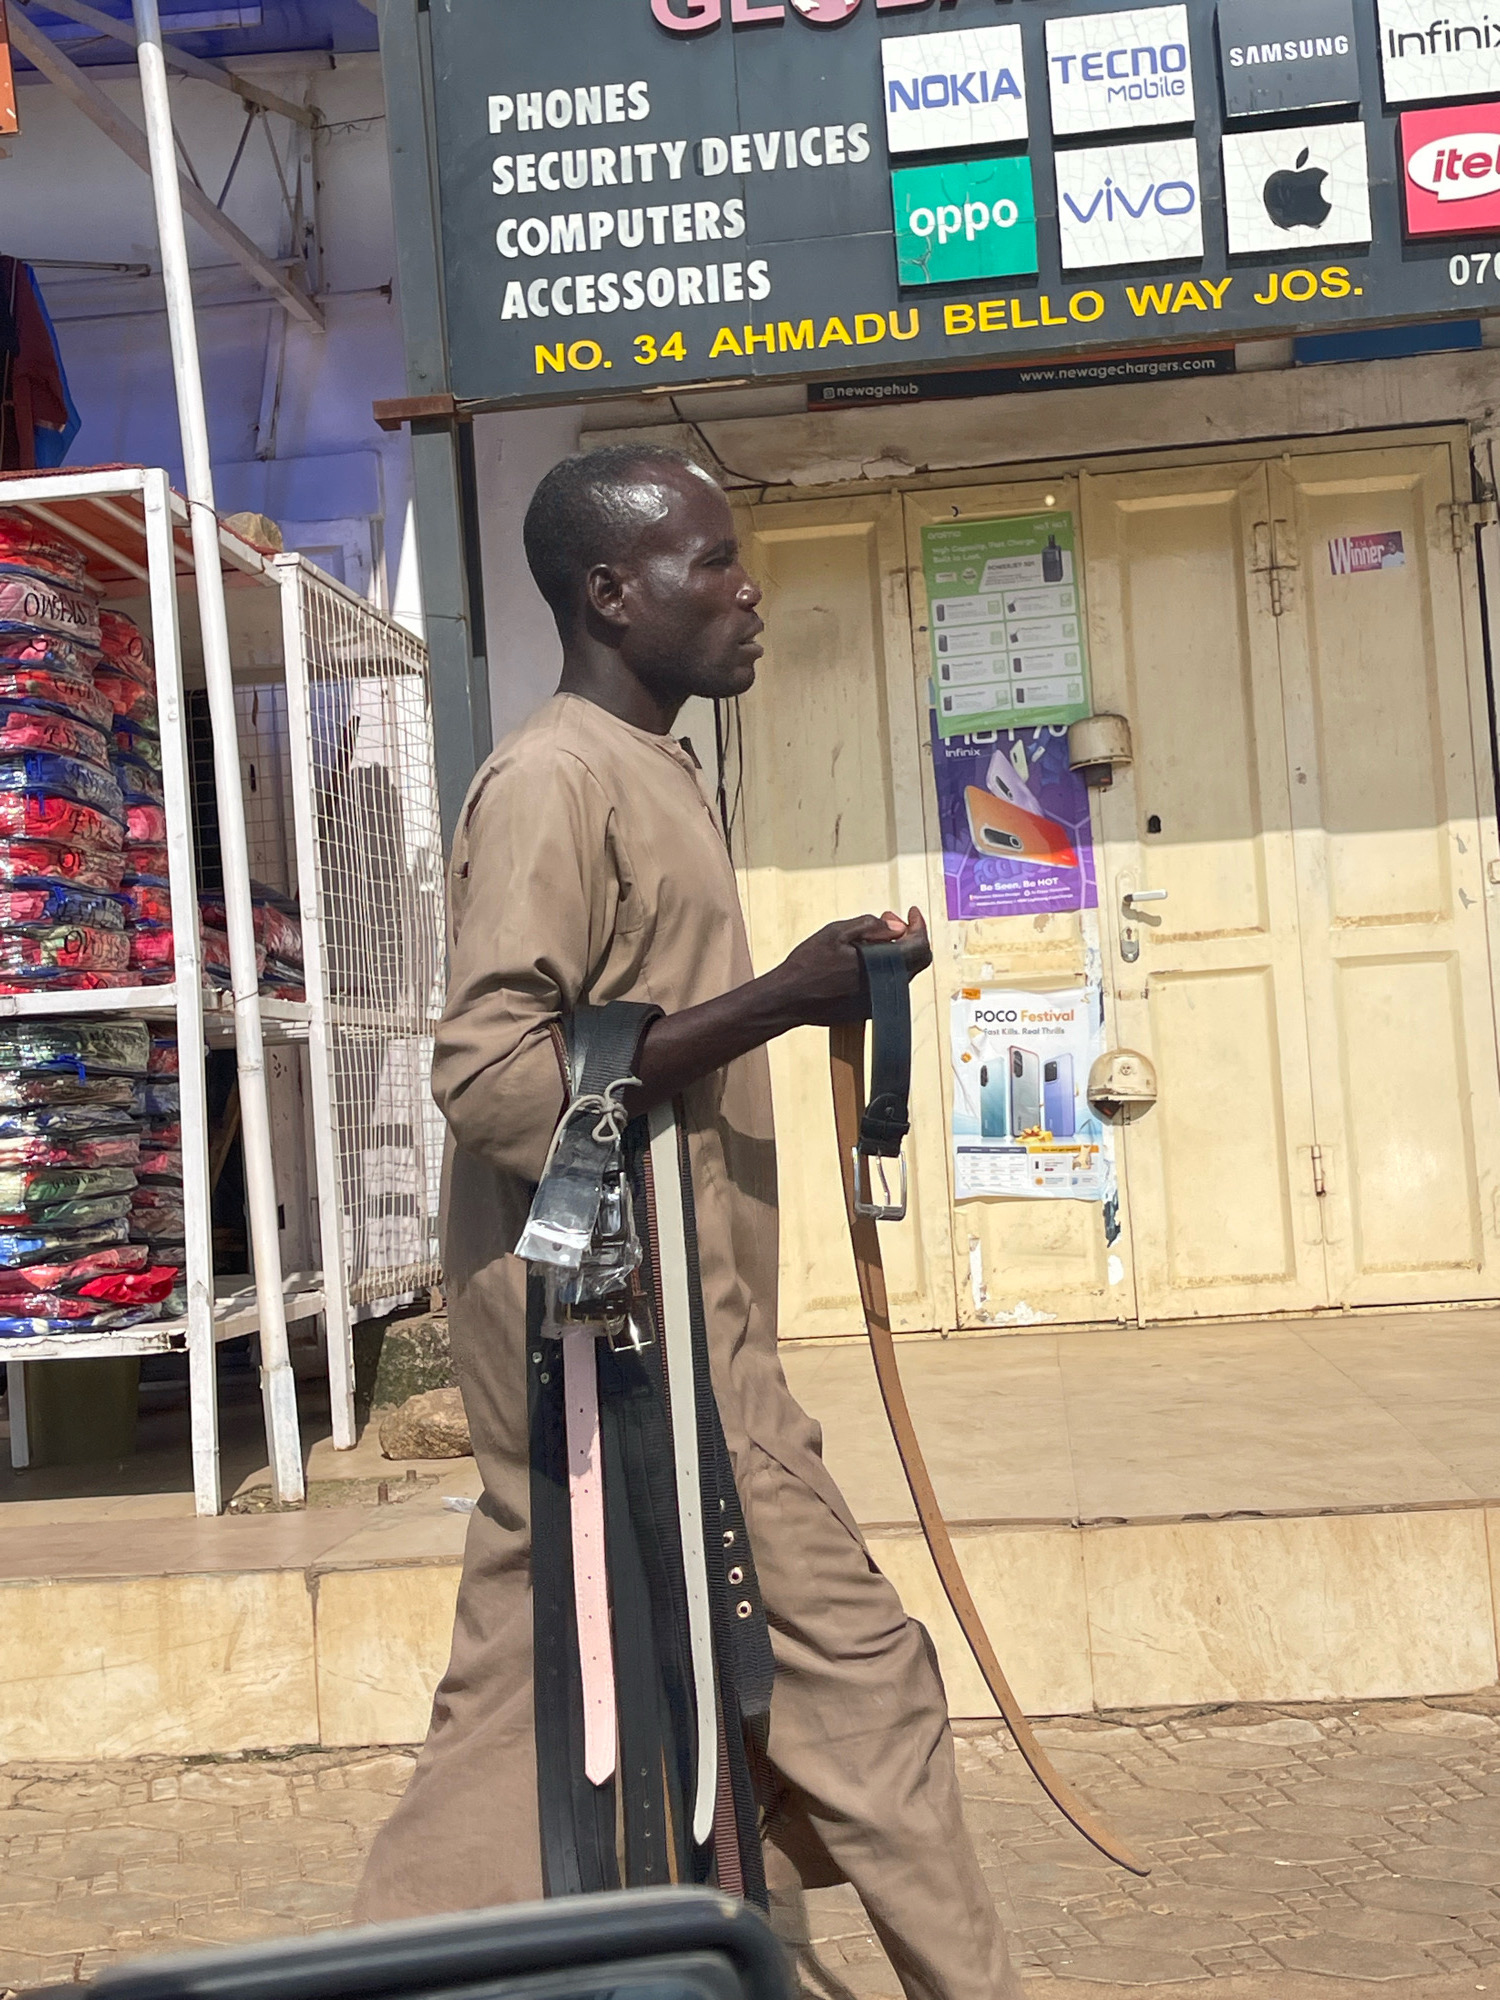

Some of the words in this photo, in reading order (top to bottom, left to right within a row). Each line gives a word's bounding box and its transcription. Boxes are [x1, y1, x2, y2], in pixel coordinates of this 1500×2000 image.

[1051, 43, 1187, 85] TECNO
[1229, 35, 1349, 67] SAMSUNG
[488, 80, 650, 134] PHONES
[889, 67, 1022, 112] NOKIA
[492, 140, 687, 195] SECURITY
[701, 123, 871, 177] DEVICES
[909, 198, 1018, 244] oppo
[1063, 177, 1195, 224] vivo
[496, 199, 745, 258] COMPUTERS
[501, 260, 771, 320] ACCESSORIES
[535, 339, 612, 374] NO.
[634, 331, 687, 366] 34
[709, 308, 920, 358] AHMADU
[944, 290, 1105, 336] BELLO
[1126, 277, 1233, 317] WAY
[1253, 266, 1363, 306] JOS.
[1020, 357, 1215, 383] www.newagechargers.com
[1330, 537, 1385, 574] Winner
[945, 748, 981, 758] Infinix
[980, 884, 993, 892] Be
[994, 882, 1021, 891] Seen,
[1023, 880, 1036, 888] Be
[1037, 877, 1059, 887] HOT
[975, 1010, 1017, 1022] POCO
[1020, 1008, 1074, 1022] Festival
[1022, 1027, 1039, 1035] Real
[1041, 1027, 1065, 1035] Thrills
